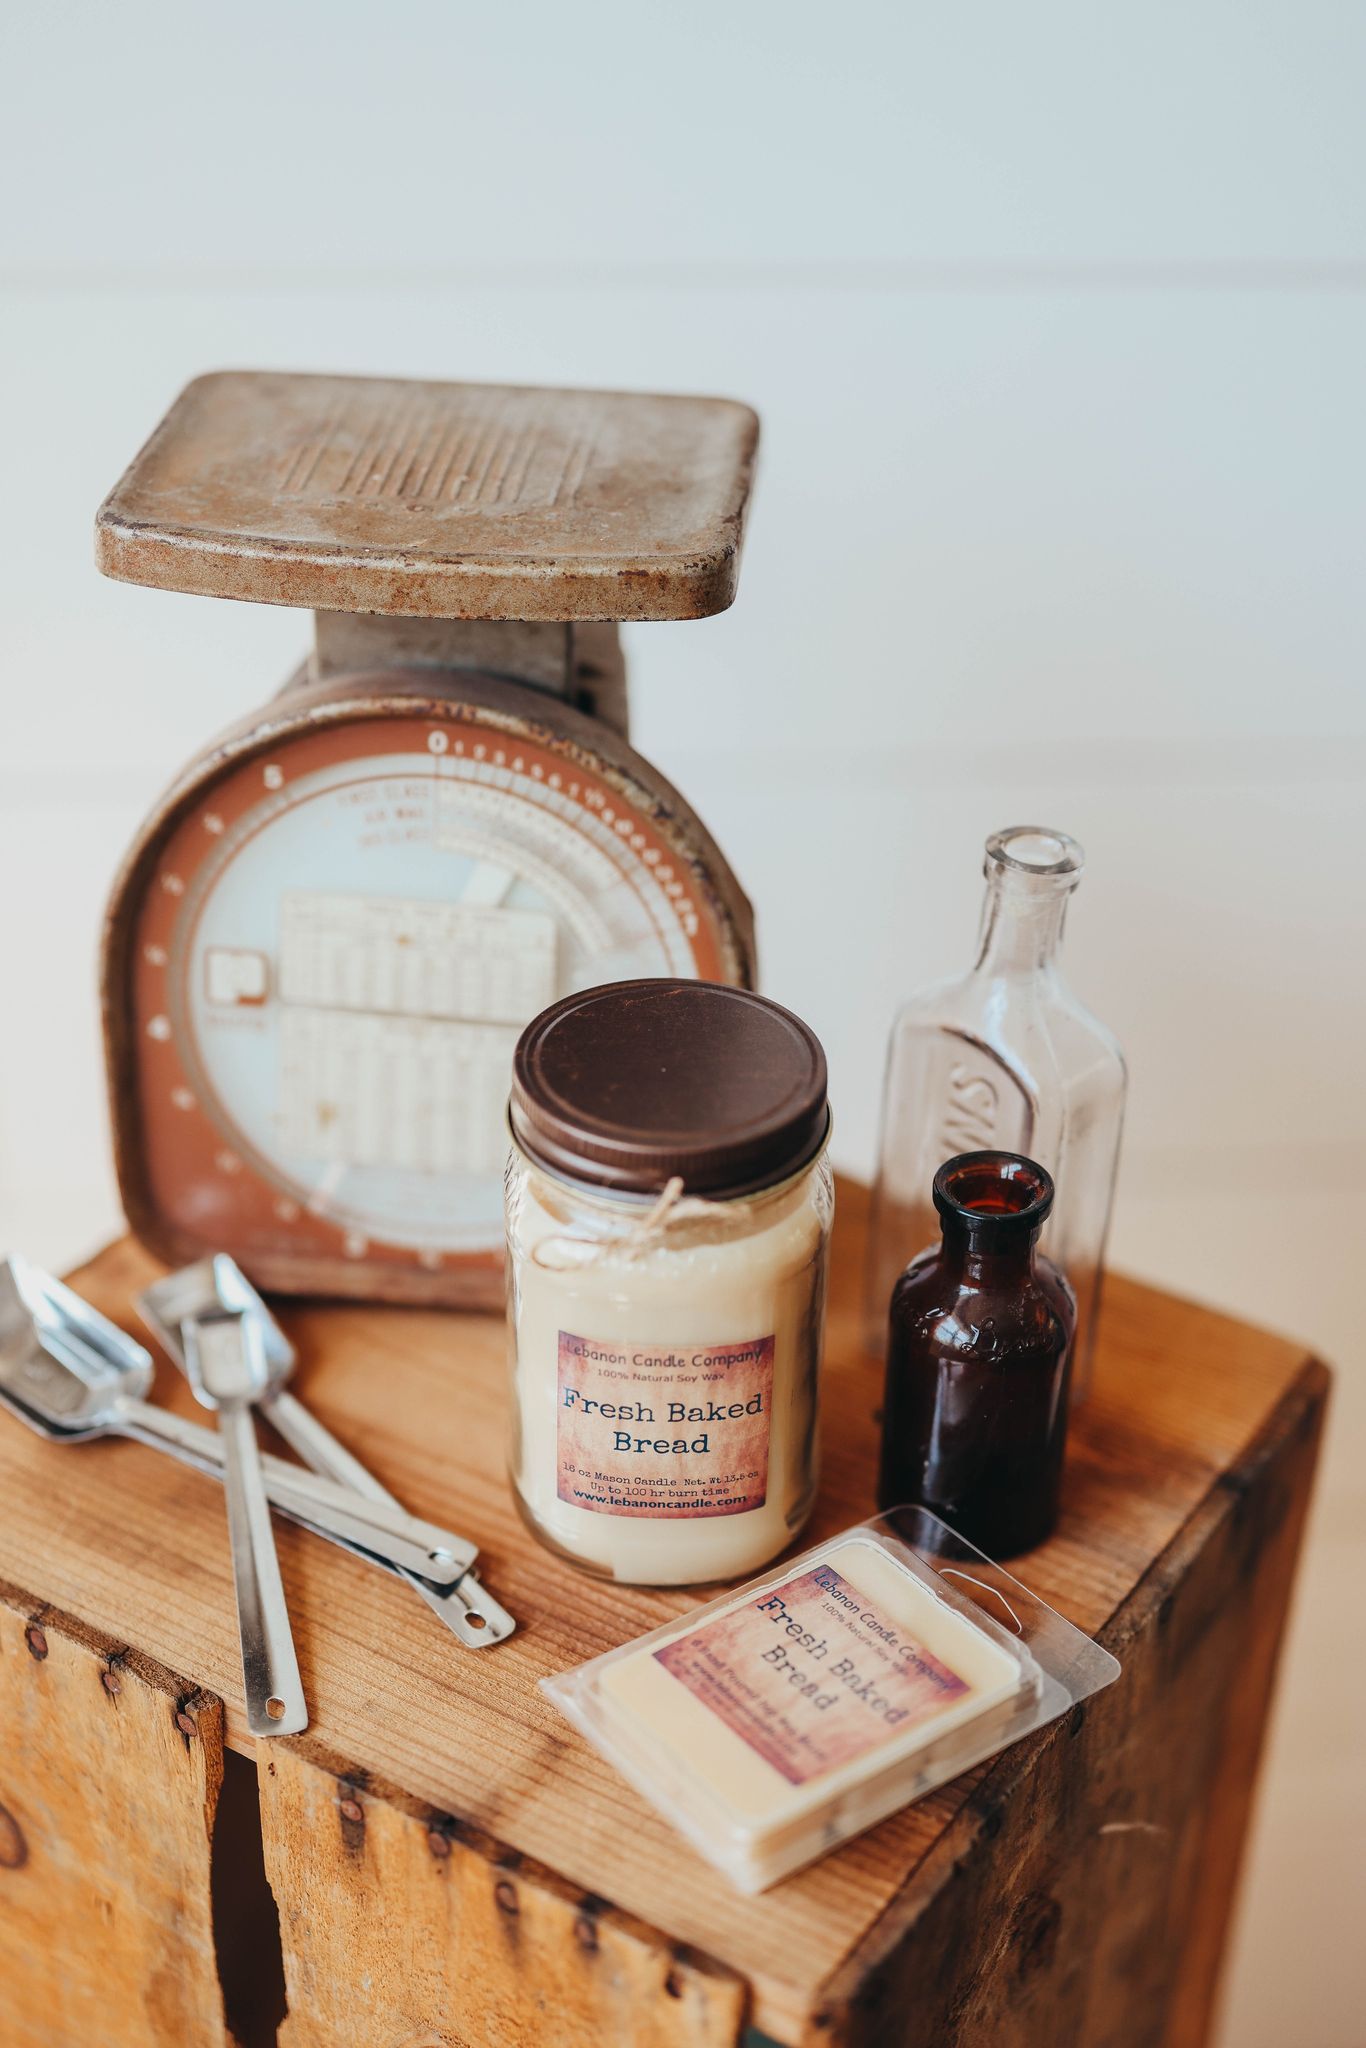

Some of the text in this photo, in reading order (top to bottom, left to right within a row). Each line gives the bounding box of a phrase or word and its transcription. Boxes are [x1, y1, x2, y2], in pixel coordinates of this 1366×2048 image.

[427, 730, 449, 754] 0
[566, 1340, 763, 1370] Lebanon Candle Company
[597, 1368, 725, 1383] 100% Natural Soy Wax
[562, 1386, 764, 1423] Fresh Baked
[612, 1430, 711, 1455] Bread
[578, 1469, 592, 1478] oz
[594, 1471, 631, 1485] Mason
[634, 1477, 677, 1487] Candle
[709, 1477, 722, 1485] Wt
[590, 1481, 730, 1498] Up to 100 hr burn time
[573, 1489, 747, 1509] www.lebanoncandle.com
[814, 1573, 860, 1613] Lebanon
[860, 1612, 899, 1647] Candle
[821, 1601, 845, 1625] 100%
[757, 1595, 830, 1662] Fresh
[829, 1657, 911, 1726] Baked
[761, 1644, 839, 1712] Bread
